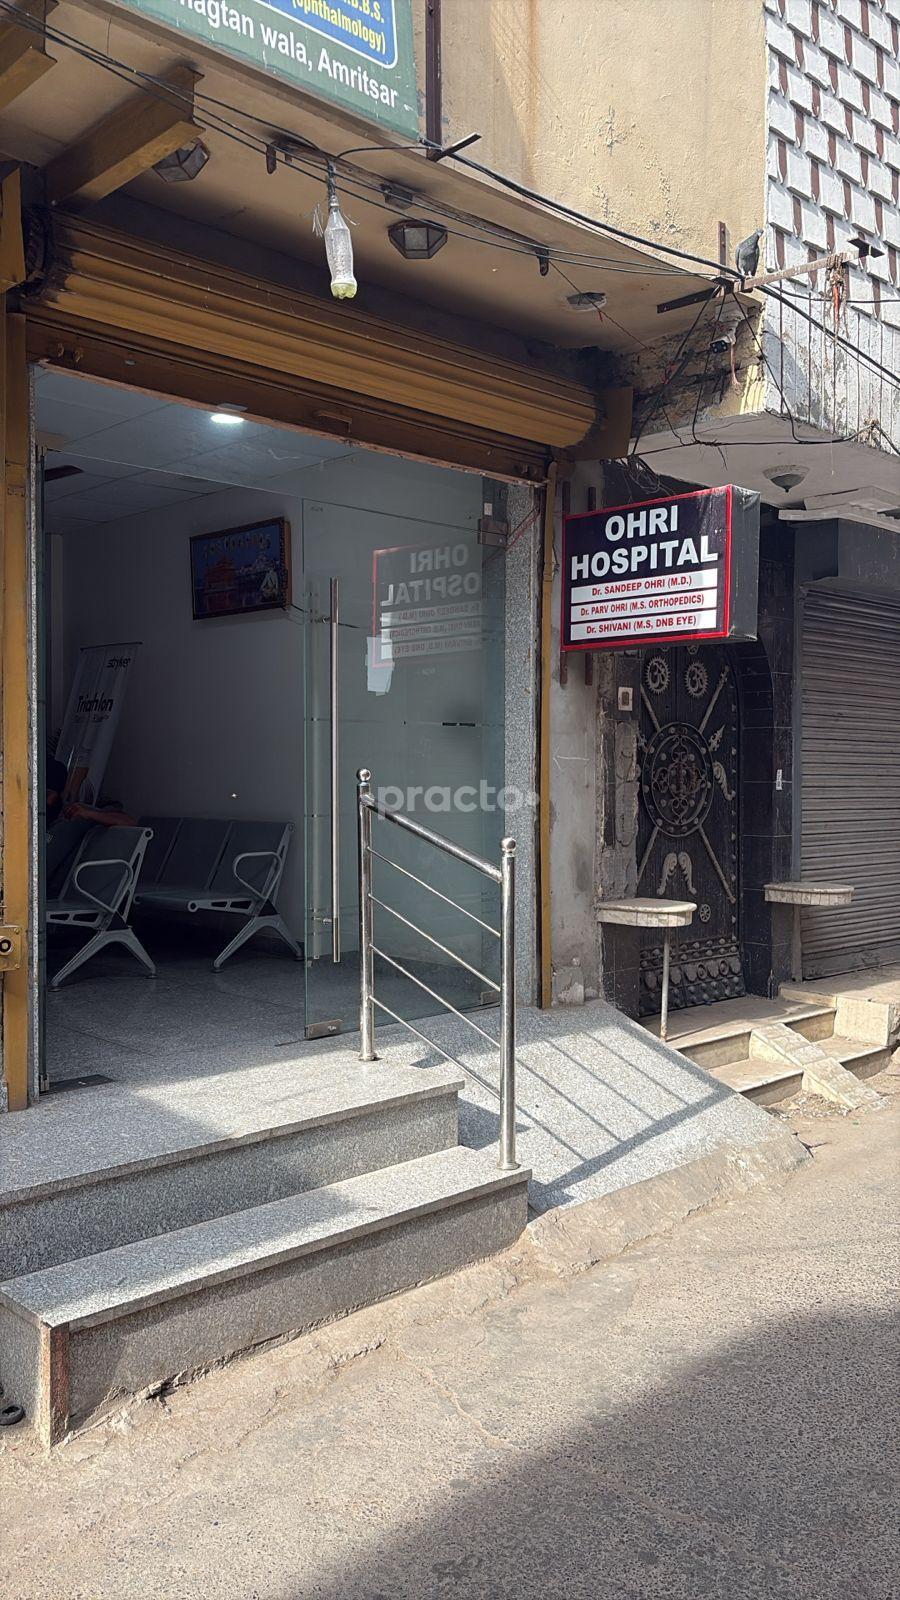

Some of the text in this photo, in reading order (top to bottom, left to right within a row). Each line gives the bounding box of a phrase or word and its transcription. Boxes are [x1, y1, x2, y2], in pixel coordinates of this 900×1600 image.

[260, 23, 313, 72] wala,
[317, 47, 399, 108] Amritsar
[605, 504, 679, 542] OHRI
[571, 535, 719, 581] HOSPITAL
[591, 575, 693, 597] Dr. SANDEEP OHRI (M.D.)
[580, 594, 705, 616] Dr. PARV OHRI (M.S. ORTHOPEDICS)
[586, 625, 597, 634] Dr.
[598, 621, 632, 633] SHIVANI
[655, 617, 674, 628] DNB
[676, 615, 697, 626] EYE)
